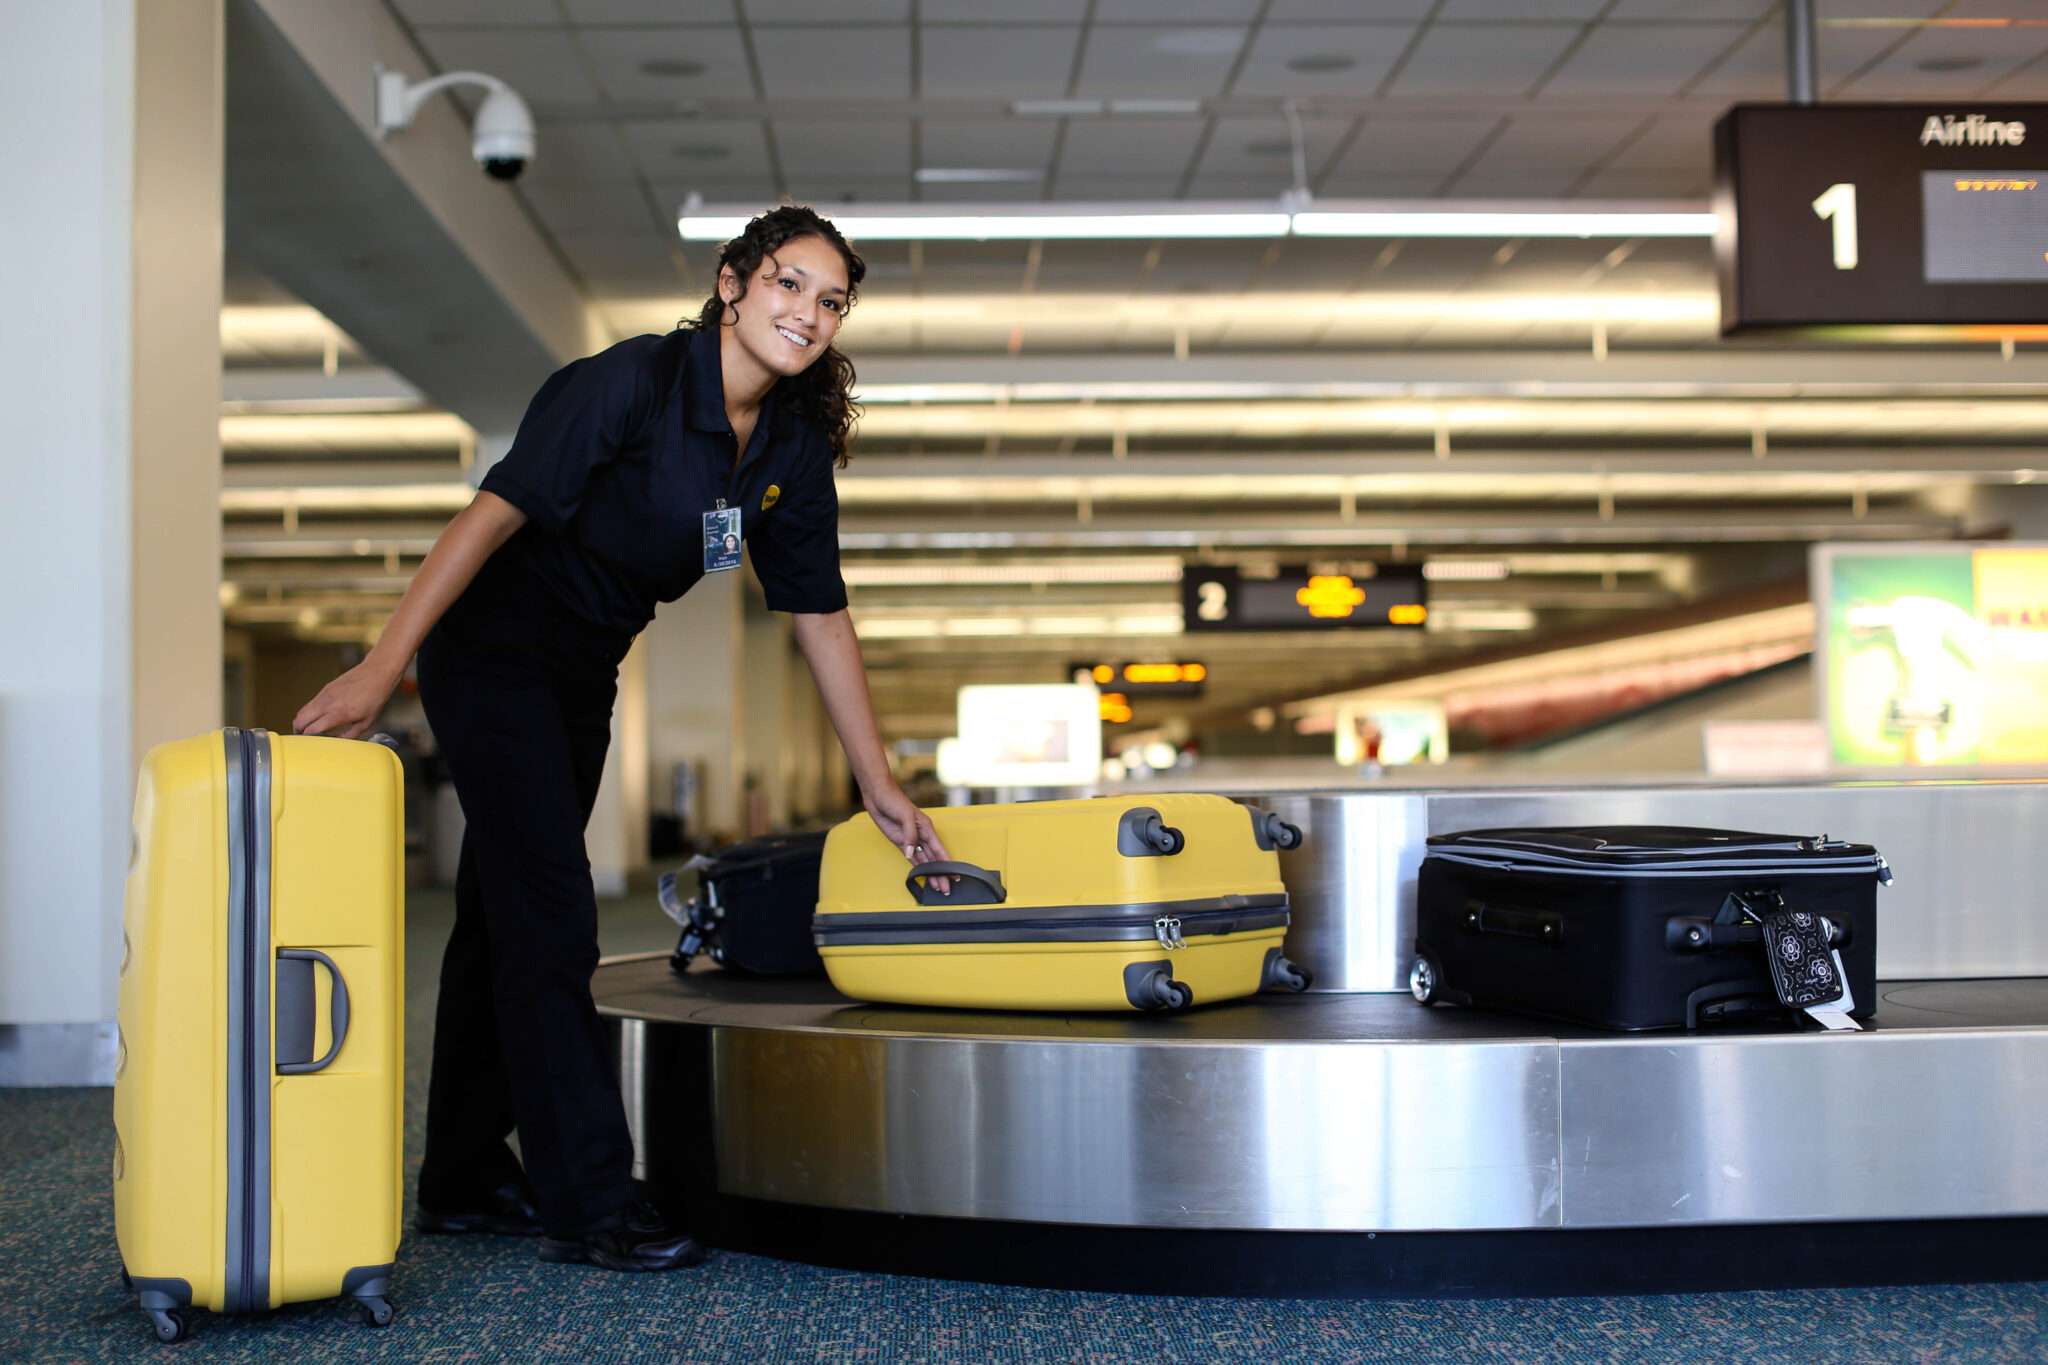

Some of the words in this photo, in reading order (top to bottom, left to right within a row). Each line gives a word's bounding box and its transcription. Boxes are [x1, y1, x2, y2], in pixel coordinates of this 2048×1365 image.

[1920, 115, 2026, 146] Airline
[1812, 183, 1858, 270] 1
[1198, 581, 1228, 621] 2
